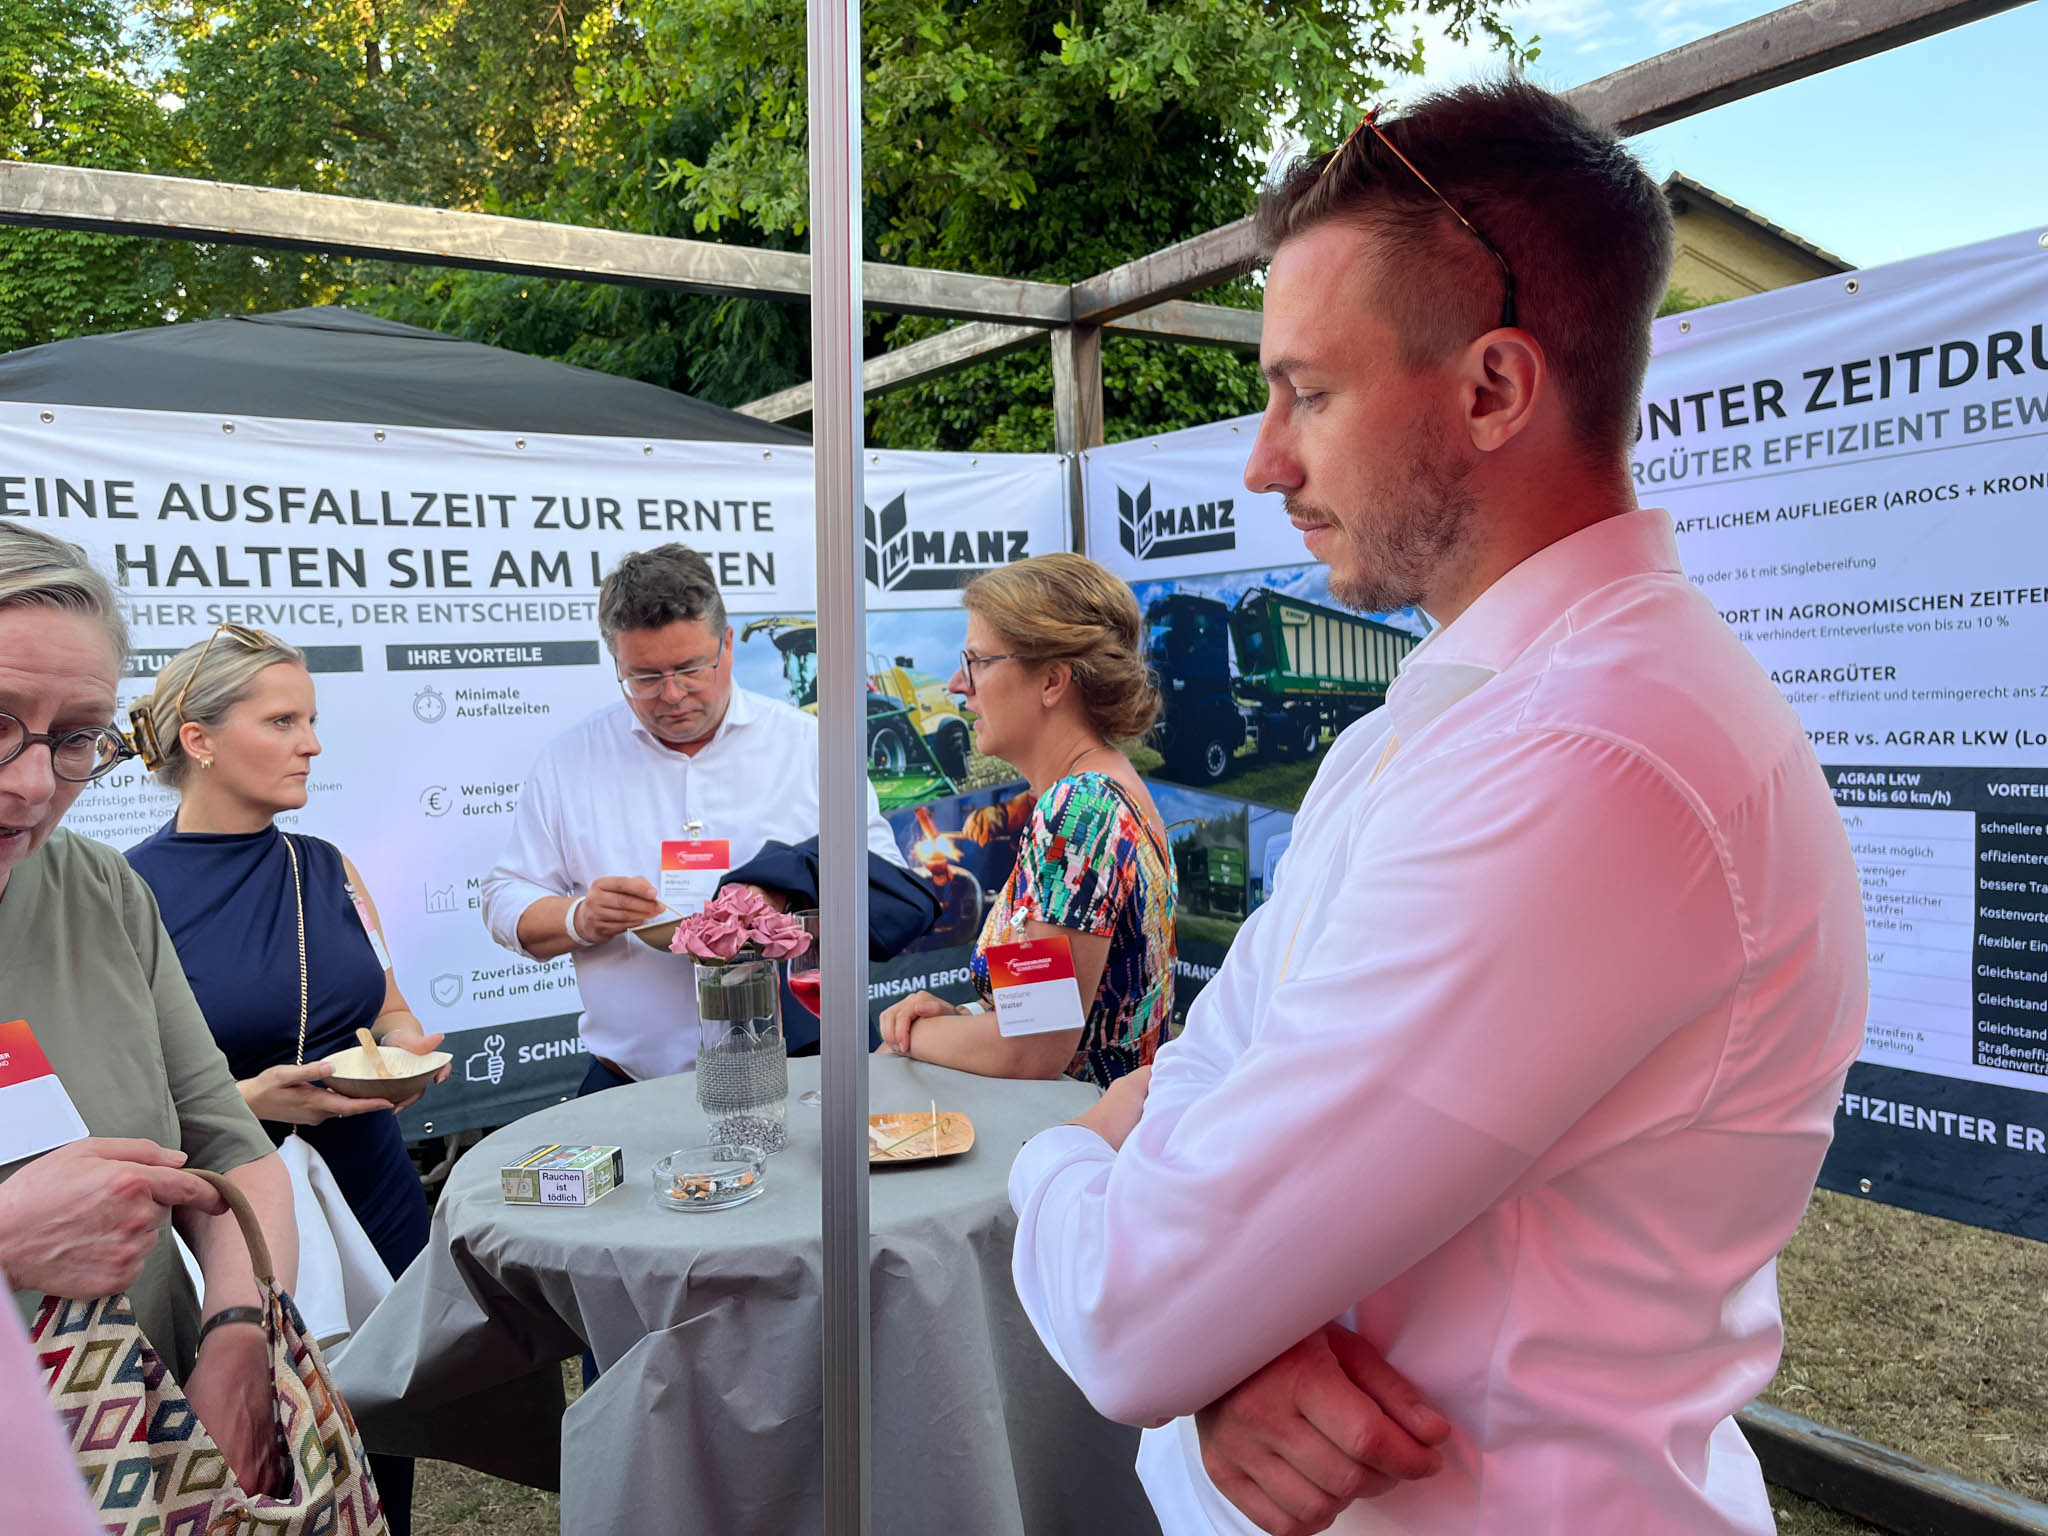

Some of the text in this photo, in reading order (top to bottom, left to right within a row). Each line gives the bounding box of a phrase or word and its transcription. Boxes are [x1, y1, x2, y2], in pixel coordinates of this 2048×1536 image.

[1764, 408, 1950, 466] EFFIZIENT
[0, 476, 775, 532] EINE AUSFALLZEIT ZUR ERNTE
[1675, 473, 2048, 533] AFTLICHEM AUFLIEGER (AROCS + KRON
[1155, 498, 1235, 537] MANZ
[912, 531, 1029, 564] MANZ
[115, 543, 368, 588] HALTEN
[387, 548, 473, 589] SIE
[489, 549, 573, 588] AM
[1707, 570, 1731, 582] oder
[1735, 567, 1748, 580] 36
[1759, 565, 1779, 577] mit
[1781, 556, 1877, 577] Singlebereifung
[206, 604, 343, 628] SERVICE,
[352, 604, 408, 624] DER
[417, 602, 597, 624] ENTSCHEIDET
[1766, 607, 1783, 621] IN
[1789, 593, 1963, 620] AGRONOMISCHEN
[1757, 627, 1816, 641] verhindert
[1820, 621, 1904, 638] Ernteverluste
[1908, 620, 1931, 632] von
[1935, 618, 1953, 631] bis
[1957, 618, 1972, 630] zu
[1977, 616, 1993, 628] 10
[1997, 615, 2009, 627] %
[407, 647, 543, 665] IHRE VORTEILE
[1770, 663, 1896, 684] AGRARGÜTER
[455, 687, 520, 701] Minimale
[1784, 690, 1818, 704] güter
[1828, 688, 1880, 702] effizient
[1884, 688, 1908, 701] und
[1912, 686, 2008, 701] termingerecht
[2013, 687, 2036, 698] ans
[456, 702, 550, 718] Ausfallzeiten
[1855, 733, 1879, 745] vs.
[1885, 730, 1955, 745] AGRAR
[1962, 730, 2008, 745] LKW
[110, 775, 134, 788] UP
[1837, 772, 1920, 786] AGRAR LKW
[460, 782, 520, 796] Weniger
[1868, 788, 1888, 802] bis
[1890, 790, 1907, 802] 60
[1910, 789, 1952, 807] km/h)
[66, 810, 146, 824] Transparente
[462, 802, 502, 816] durch
[1980, 821, 2043, 836] schnellere
[1890, 845, 1934, 858] möglich
[1863, 866, 1907, 877] weniger
[1980, 877, 2026, 892] bessere
[1875, 893, 1943, 908] gesetzlicher
[1899, 921, 1913, 932] im
[1979, 933, 2027, 950] flexibler
[472, 959, 566, 982] Zuverlässiger
[930, 967, 971, 988] ERFO
[1977, 964, 2047, 983] Gleichstand
[473, 985, 504, 1001] rund
[509, 985, 529, 995] um
[534, 980, 554, 992] die
[1977, 992, 2047, 1012] Gleichstand
[1977, 1020, 2047, 1041] Gleichstand
[1840, 1093, 2047, 1154] FIZIENTER ER
[542, 1172, 580, 1181] Rauchen
[556, 1183, 567, 1191] ist
[548, 1194, 577, 1202] tödlich
